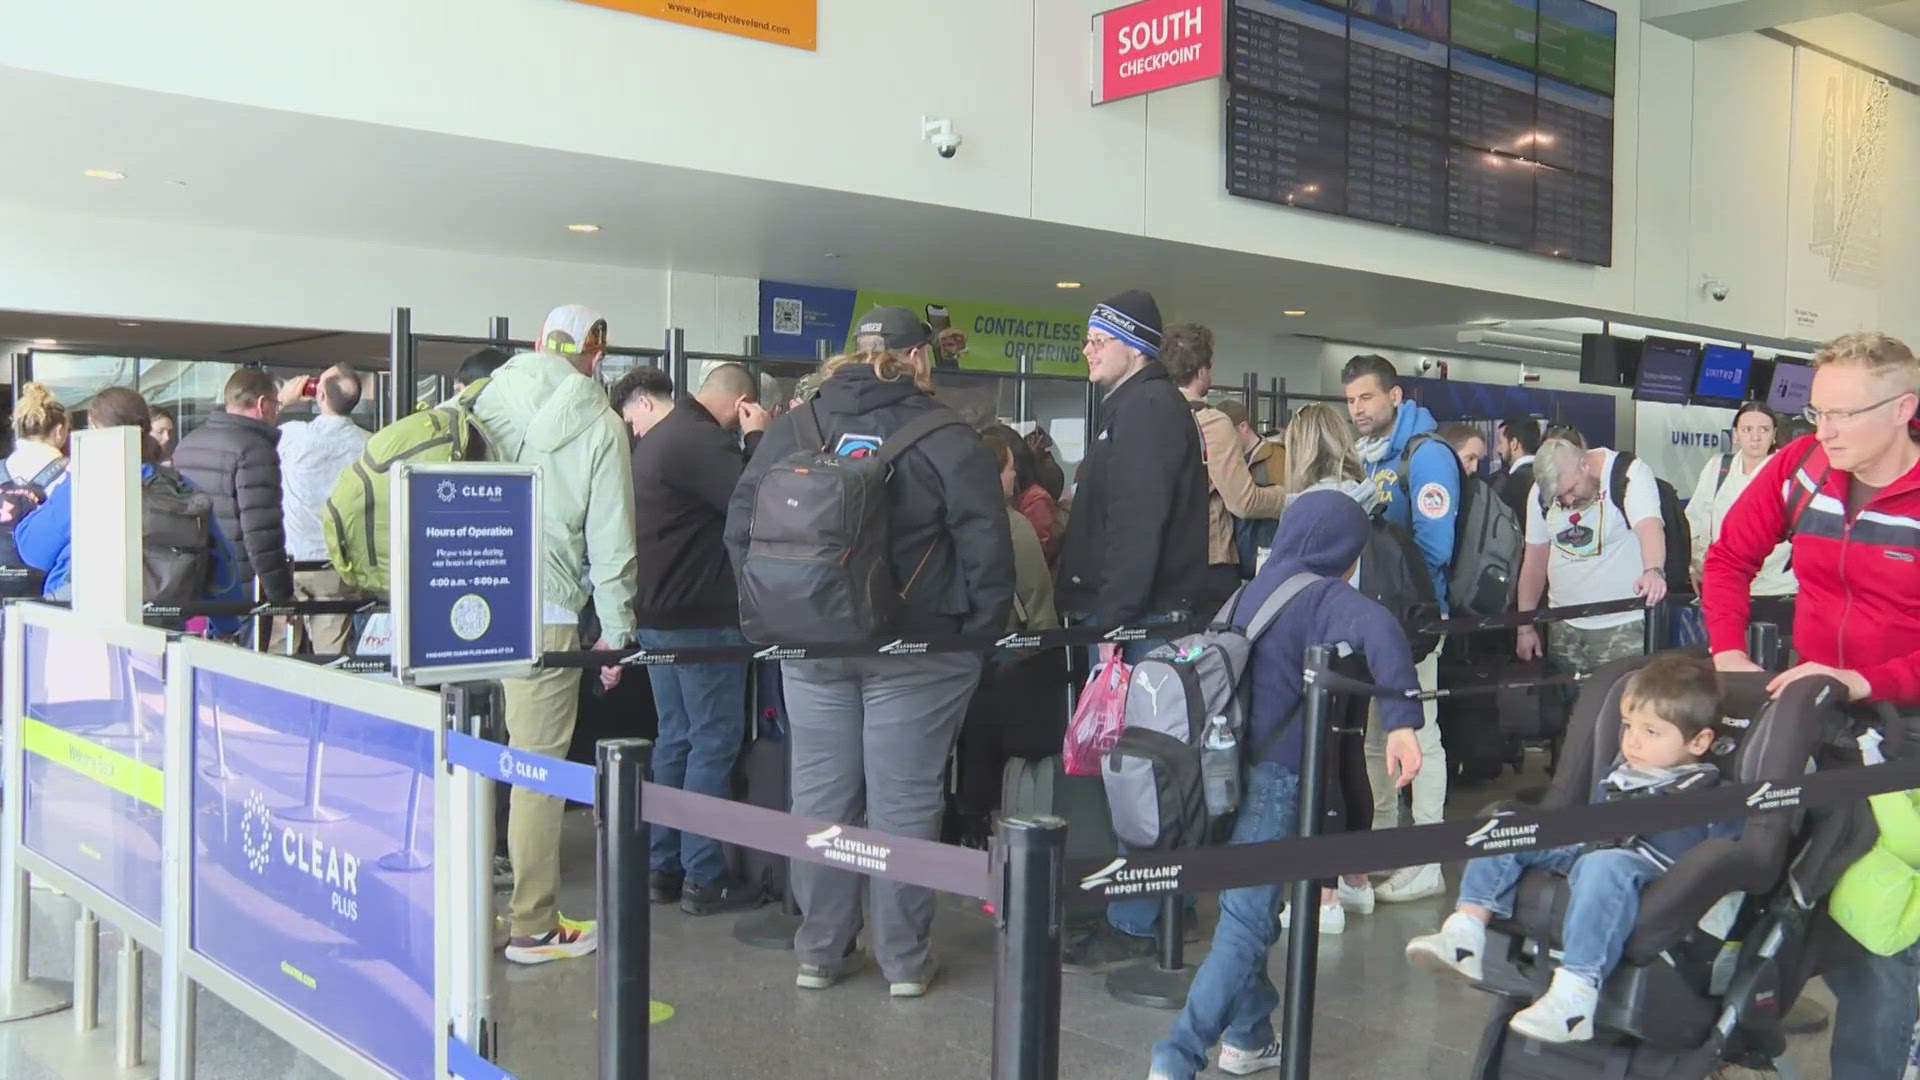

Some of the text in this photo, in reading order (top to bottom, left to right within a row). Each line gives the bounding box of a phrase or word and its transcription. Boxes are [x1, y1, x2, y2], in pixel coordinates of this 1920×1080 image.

[667, 2, 790, 34] www.typecitycleveland.com
[1118, 6, 1202, 55] SOUTH
[1119, 43, 1202, 78] CHECKPOINT
[974, 315, 1081, 342] CONTACTLESS
[1004, 340, 1080, 363] ORDERING
[1705, 367, 1734, 380] UNITED
[1672, 431, 1719, 448] UNITED
[462, 486, 502, 497] CLEAR
[426, 526, 513, 538] Hours of Operation
[516, 760, 546, 782] CLEAR
[1490, 825, 1536, 839] CLEVELAND
[834, 837, 887, 859] CLEVELAND
[282, 827, 357, 895] CLEAR
[824, 848, 887, 872] AIRPORT SYSTEM
[1116, 866, 1179, 881] CLEVELAND
[1104, 879, 1179, 895] AIRPORT SYSTEM
[332, 891, 358, 921] PLUS
